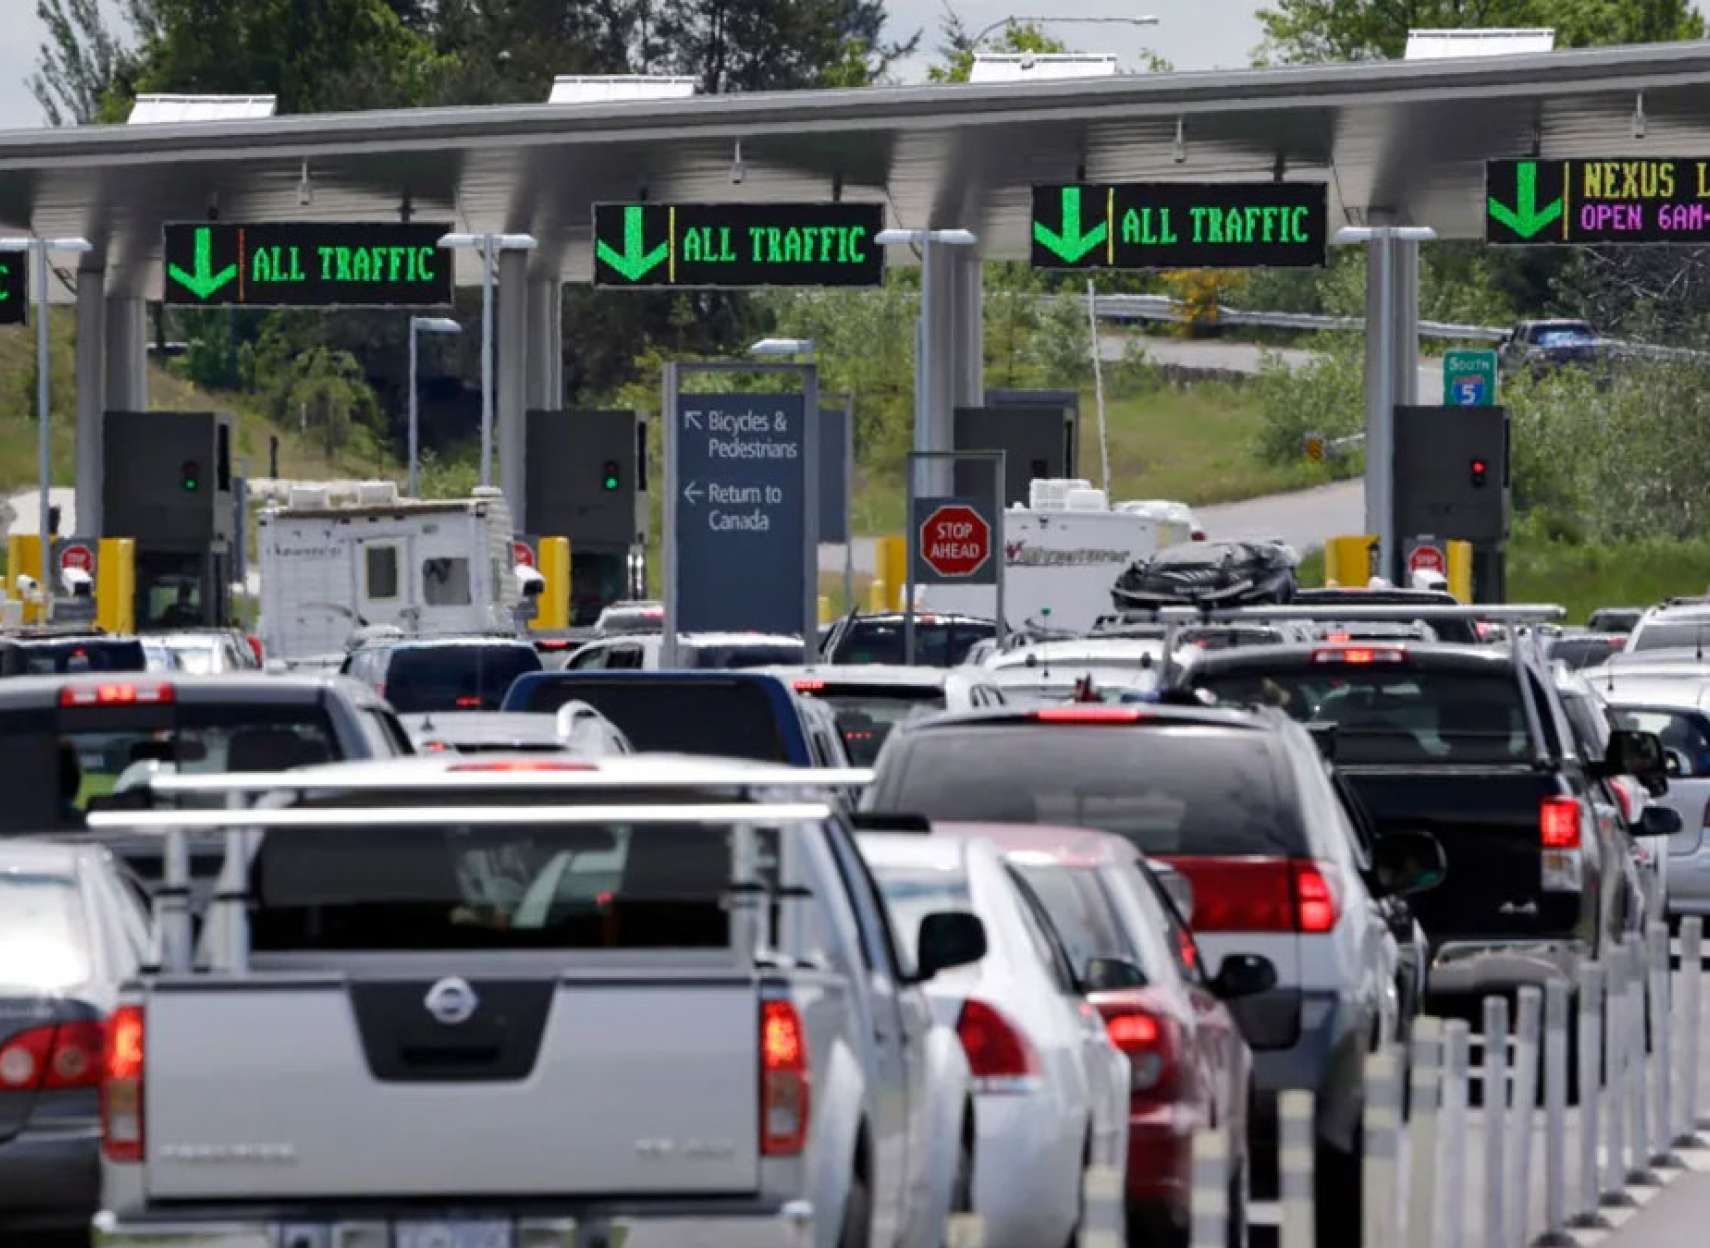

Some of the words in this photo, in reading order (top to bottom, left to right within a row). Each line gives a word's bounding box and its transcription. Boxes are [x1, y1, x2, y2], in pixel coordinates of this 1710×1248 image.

[1583, 162, 1675, 198] NEXUS
[1121, 207, 1177, 244] ALL
[1190, 206, 1309, 242] TRAFFIC
[1581, 203, 1642, 230] OPEN
[683, 227, 737, 263] ALL
[750, 225, 866, 263] TRAFFIC
[251, 246, 305, 282] ALL
[317, 246, 435, 282] TRAFFIC
[1461, 383, 1476, 404] 5
[708, 410, 769, 436] Bicycles
[774, 411, 787, 432] &
[708, 437, 797, 458] Pedestrians
[708, 483, 760, 503] Return
[765, 485, 782, 503] to
[708, 508, 770, 530] Canada
[937, 522, 973, 539] STOP
[930, 542, 981, 558] AHEAD
